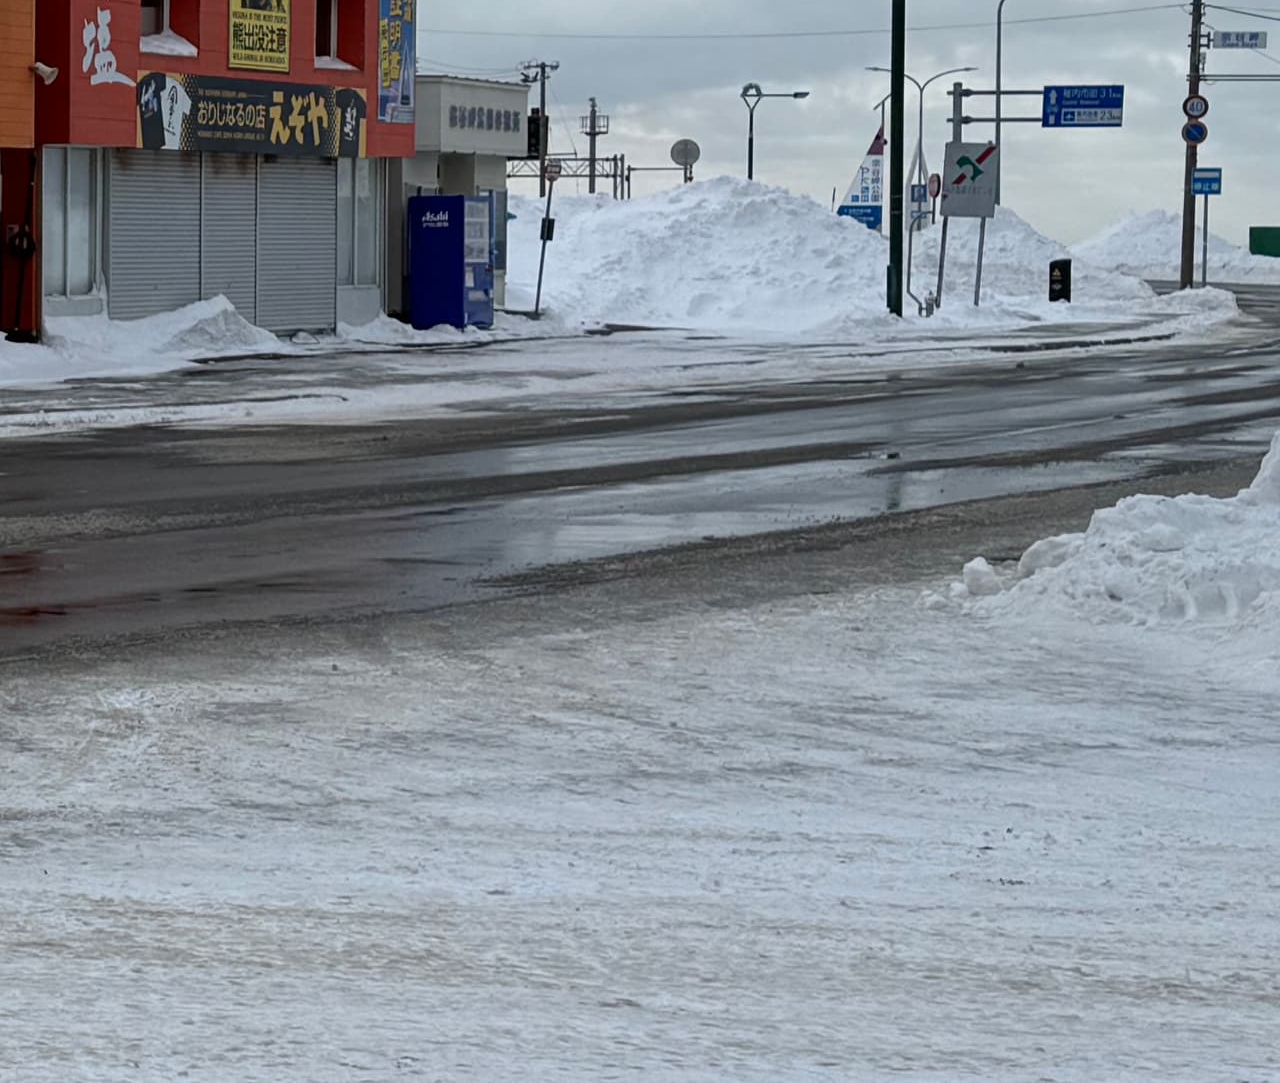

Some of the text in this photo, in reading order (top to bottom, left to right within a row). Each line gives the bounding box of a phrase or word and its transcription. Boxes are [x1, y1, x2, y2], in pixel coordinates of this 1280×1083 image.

[232, 21, 287, 55] 熊出没注意
[197, 99, 267, 130] おりじなるの店
[1189, 101, 1203, 113] 40
[421, 210, 449, 223] Asahi
